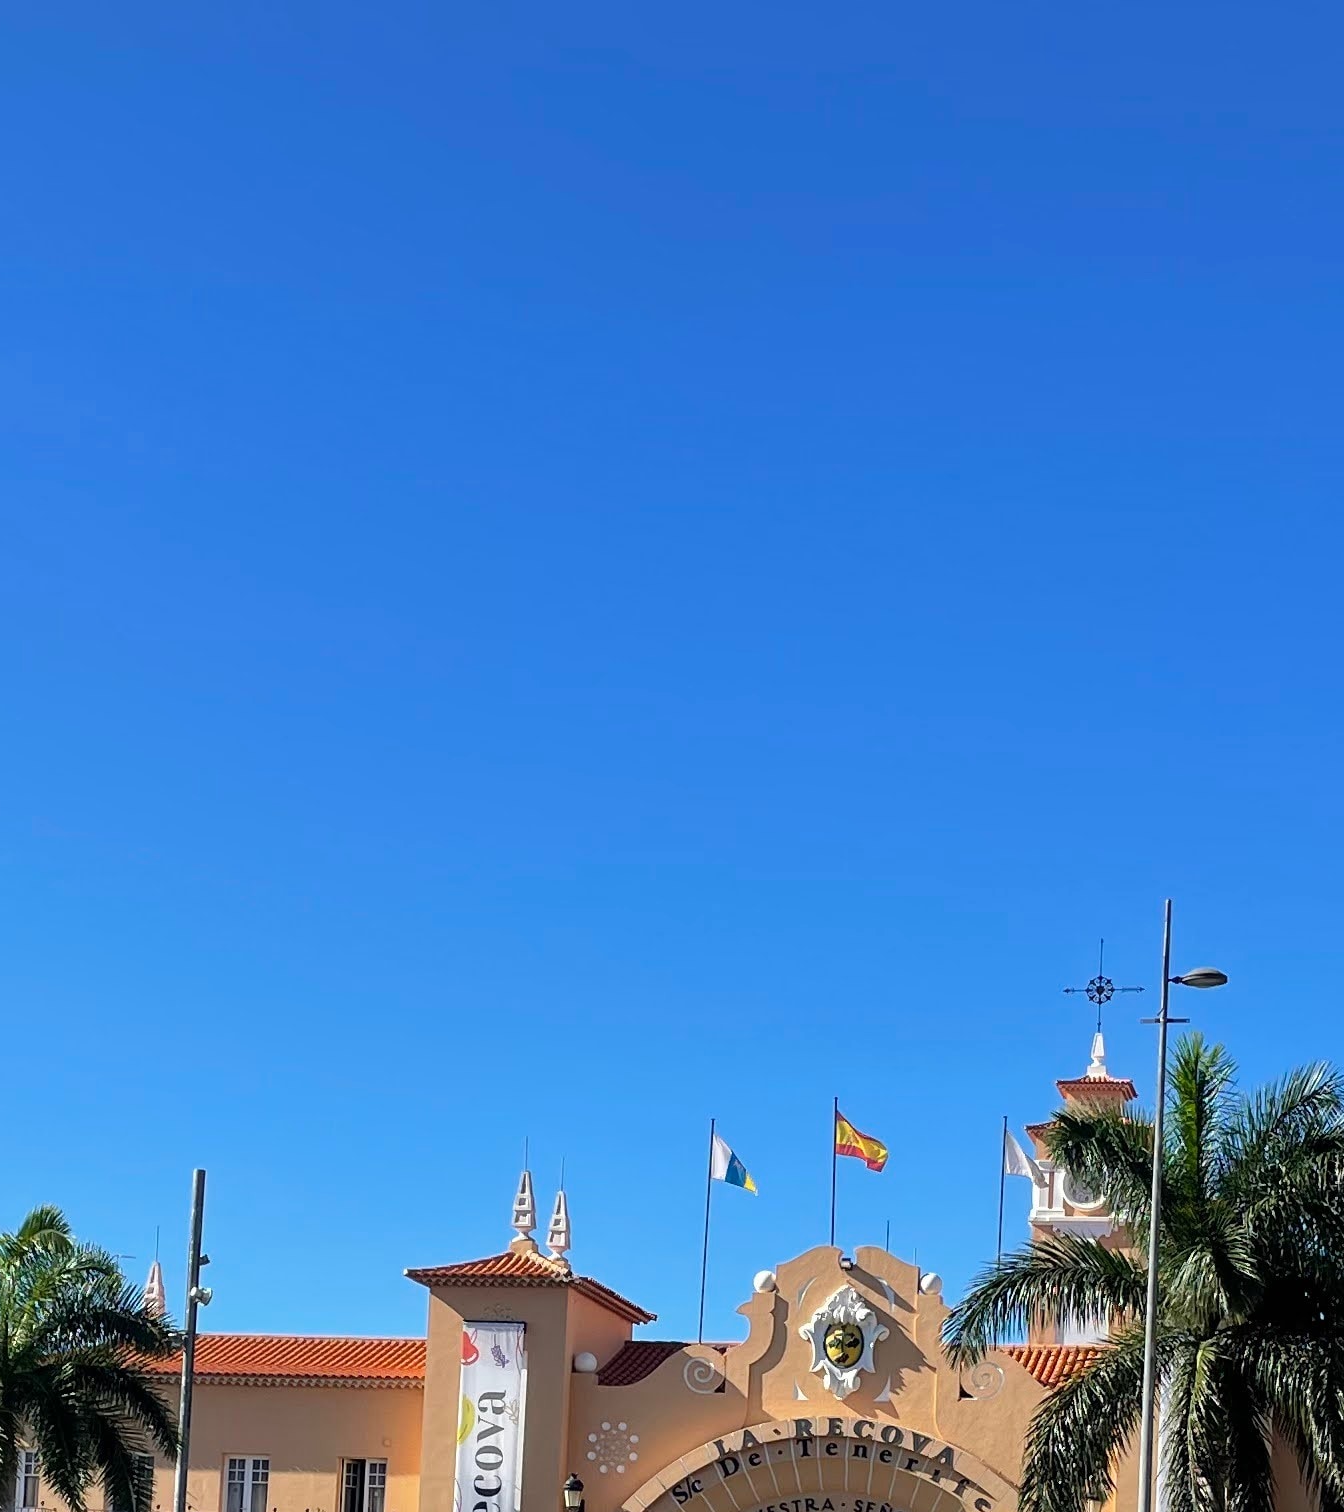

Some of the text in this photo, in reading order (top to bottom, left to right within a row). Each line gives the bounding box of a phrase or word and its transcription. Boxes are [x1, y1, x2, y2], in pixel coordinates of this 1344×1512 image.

[713, 1418, 955, 1469] LA RECOVA
[671, 1476, 704, 1505] S/c
[718, 1450, 762, 1479] De
